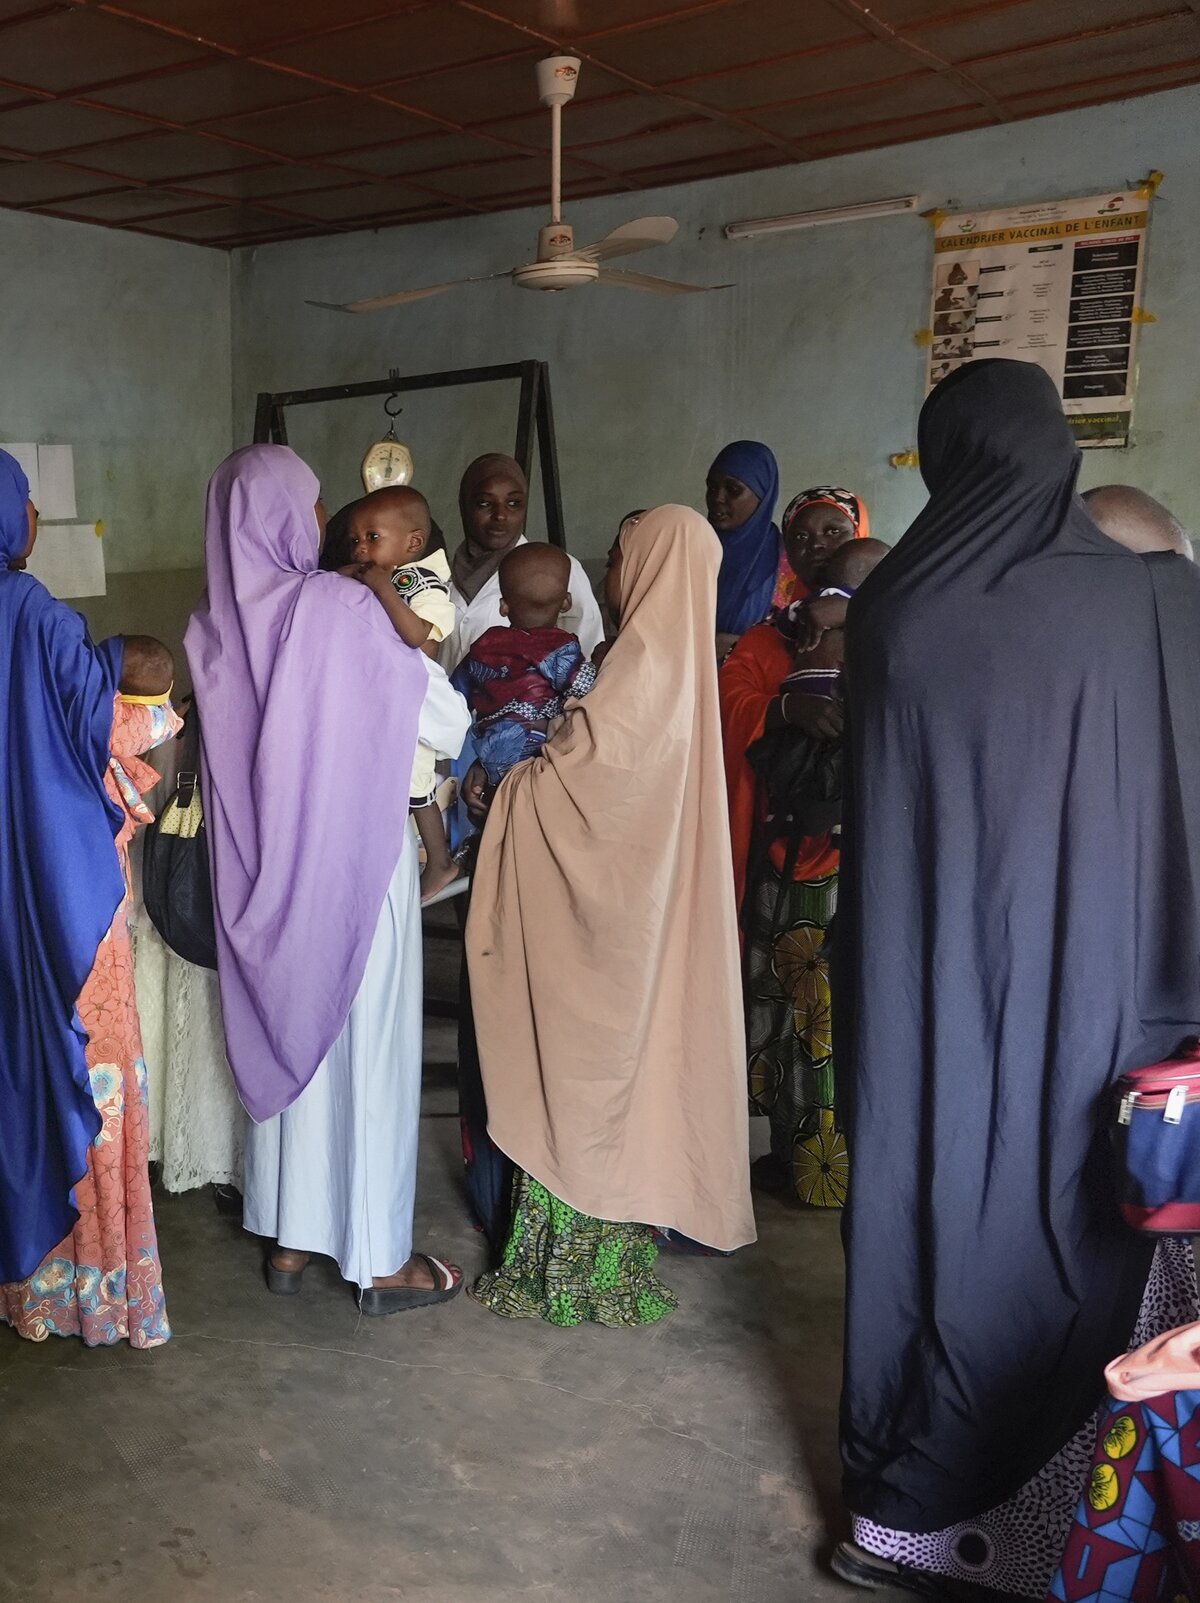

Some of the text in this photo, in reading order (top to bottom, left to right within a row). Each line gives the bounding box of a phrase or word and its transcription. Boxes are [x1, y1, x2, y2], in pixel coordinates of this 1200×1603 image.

[941, 231, 1005, 248] CALENDRIER
[1009, 226, 1060, 240] VACCINAL
[1065, 222, 1080, 233] DE
[1084, 215, 1139, 230] L'ENFANT
